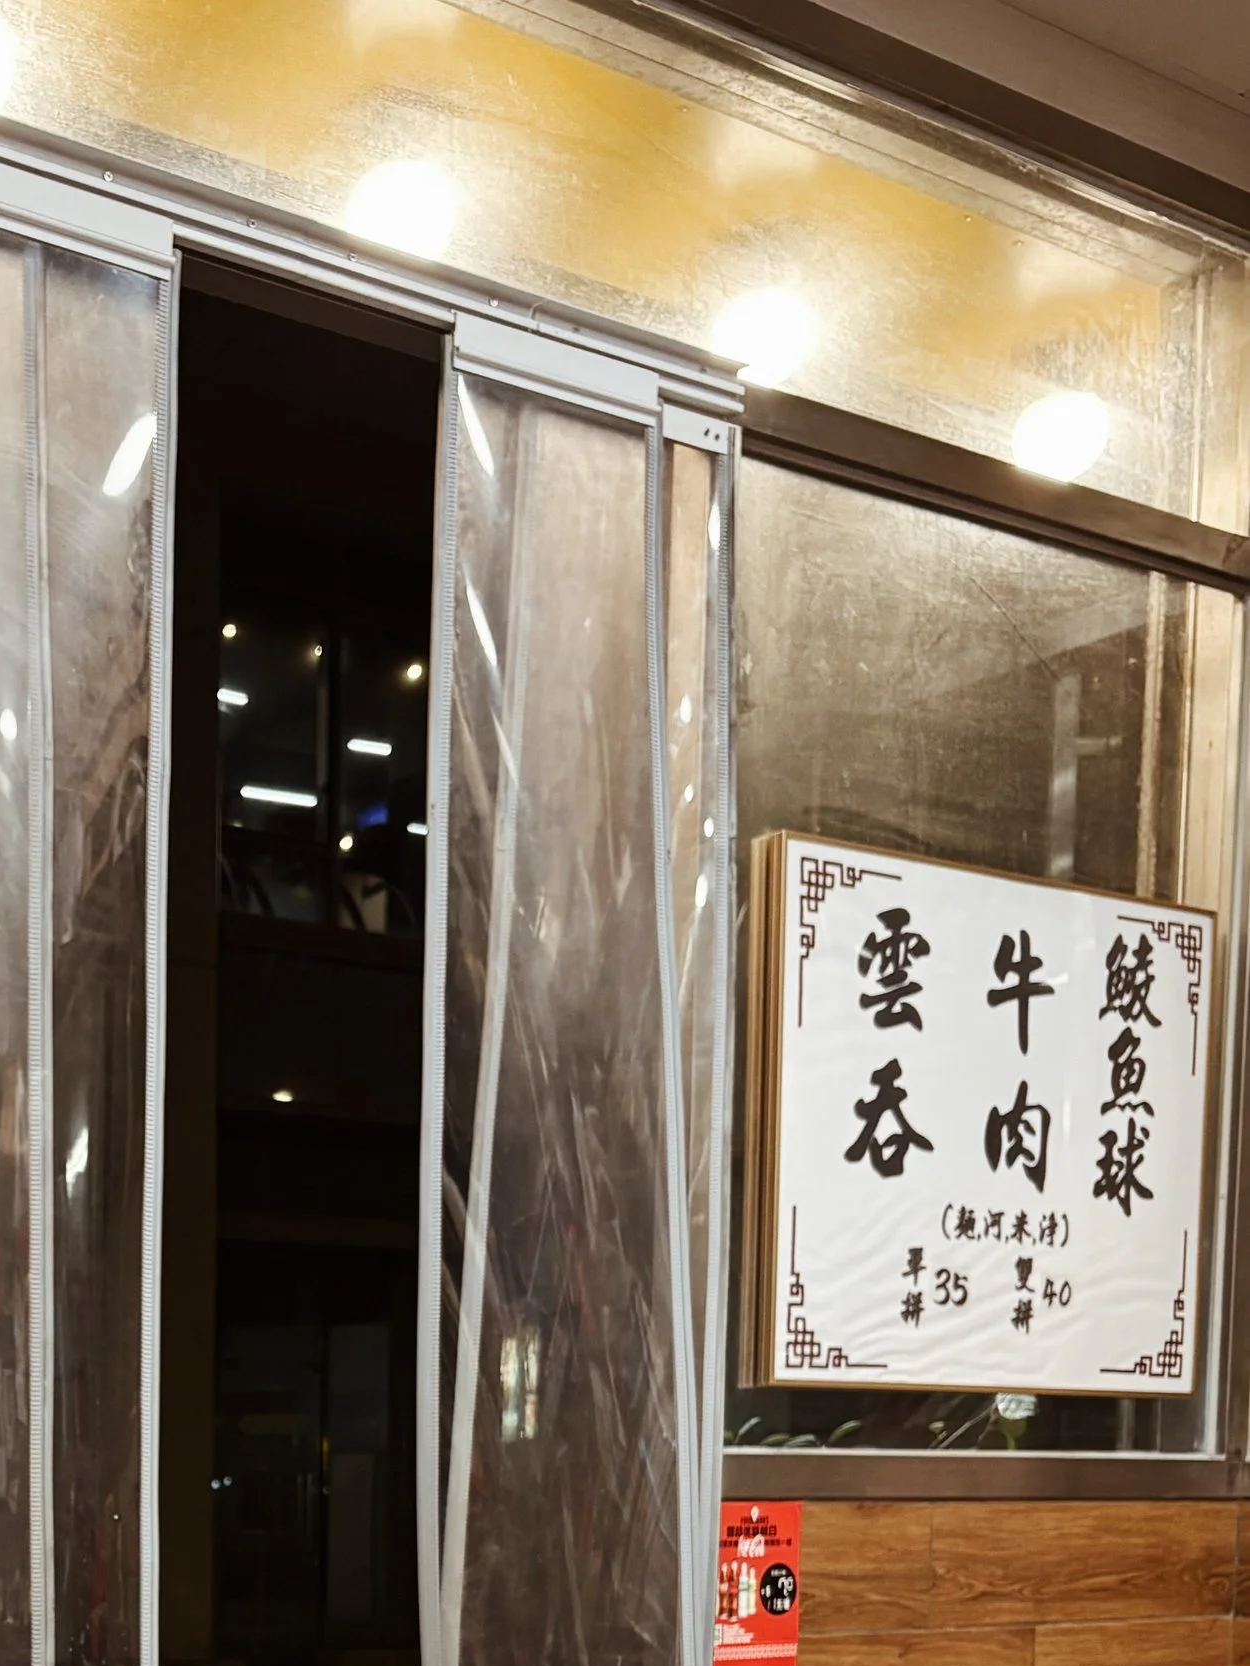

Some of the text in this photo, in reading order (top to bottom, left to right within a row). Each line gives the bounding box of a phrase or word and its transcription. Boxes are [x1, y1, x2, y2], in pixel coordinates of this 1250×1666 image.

[843, 907, 935, 1179] 雲吞
[983, 929, 1056, 1194] 牛肉
[1091, 933, 1163, 1218] 鯪魚球
[932, 1268, 968, 1307] 35
[1042, 1278, 1072, 1307] 40
